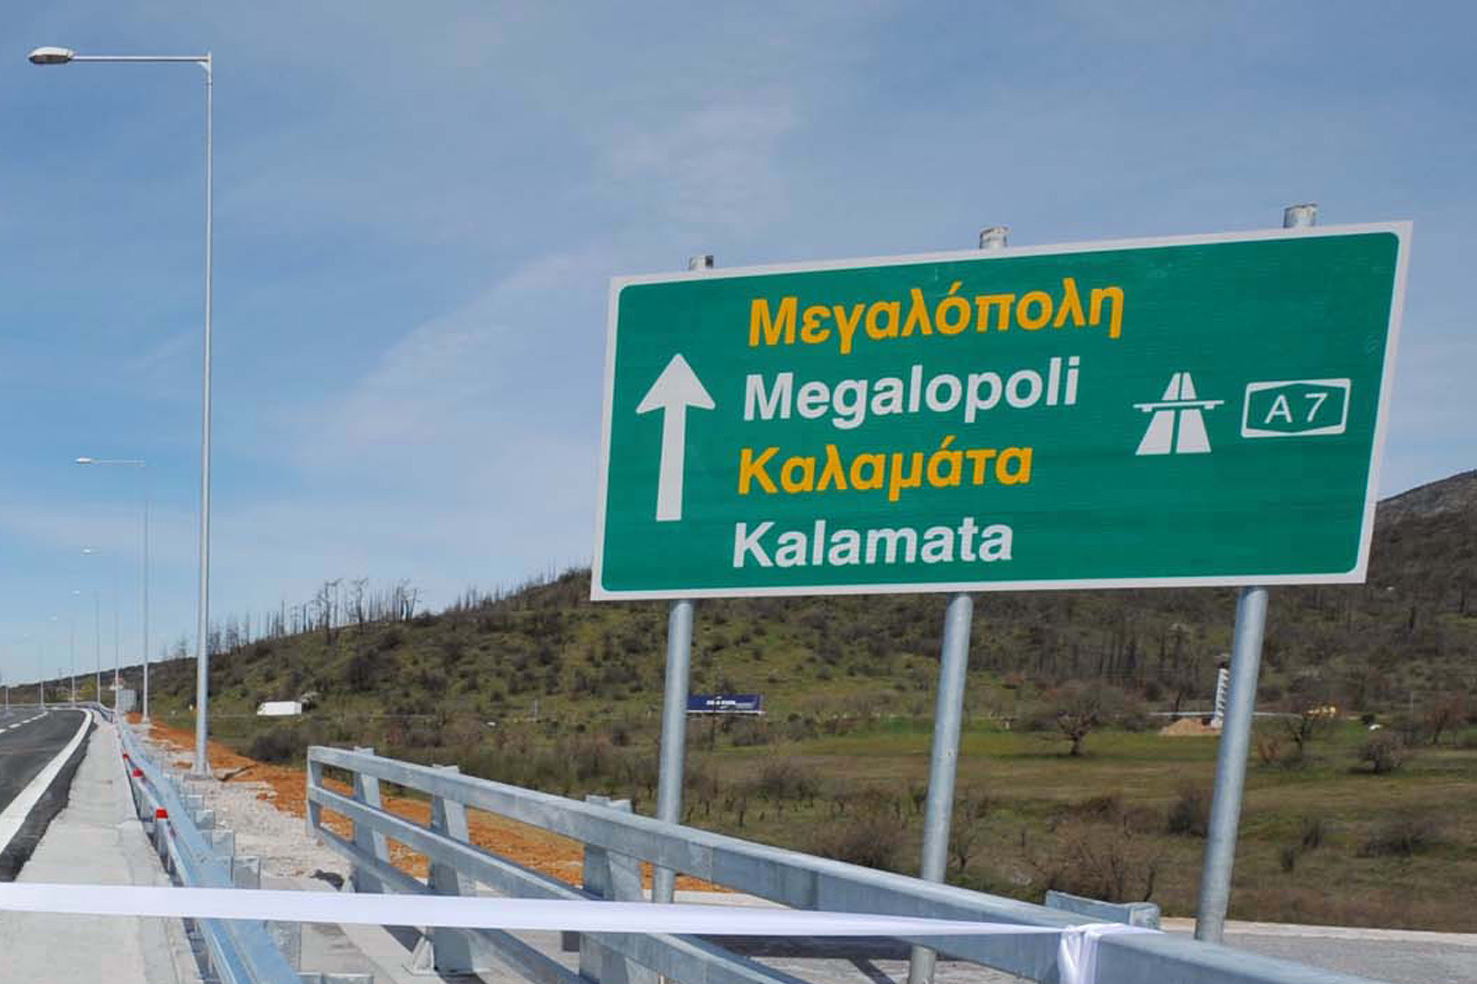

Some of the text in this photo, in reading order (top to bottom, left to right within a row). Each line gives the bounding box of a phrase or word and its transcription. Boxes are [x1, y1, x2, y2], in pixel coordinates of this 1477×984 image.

[747, 276, 1125, 354] Μεγαλόπολη
[744, 355, 1081, 430] Megalopoli
[737, 436, 1033, 501] Καλαμάτα
[733, 516, 1013, 568] Kalamata
